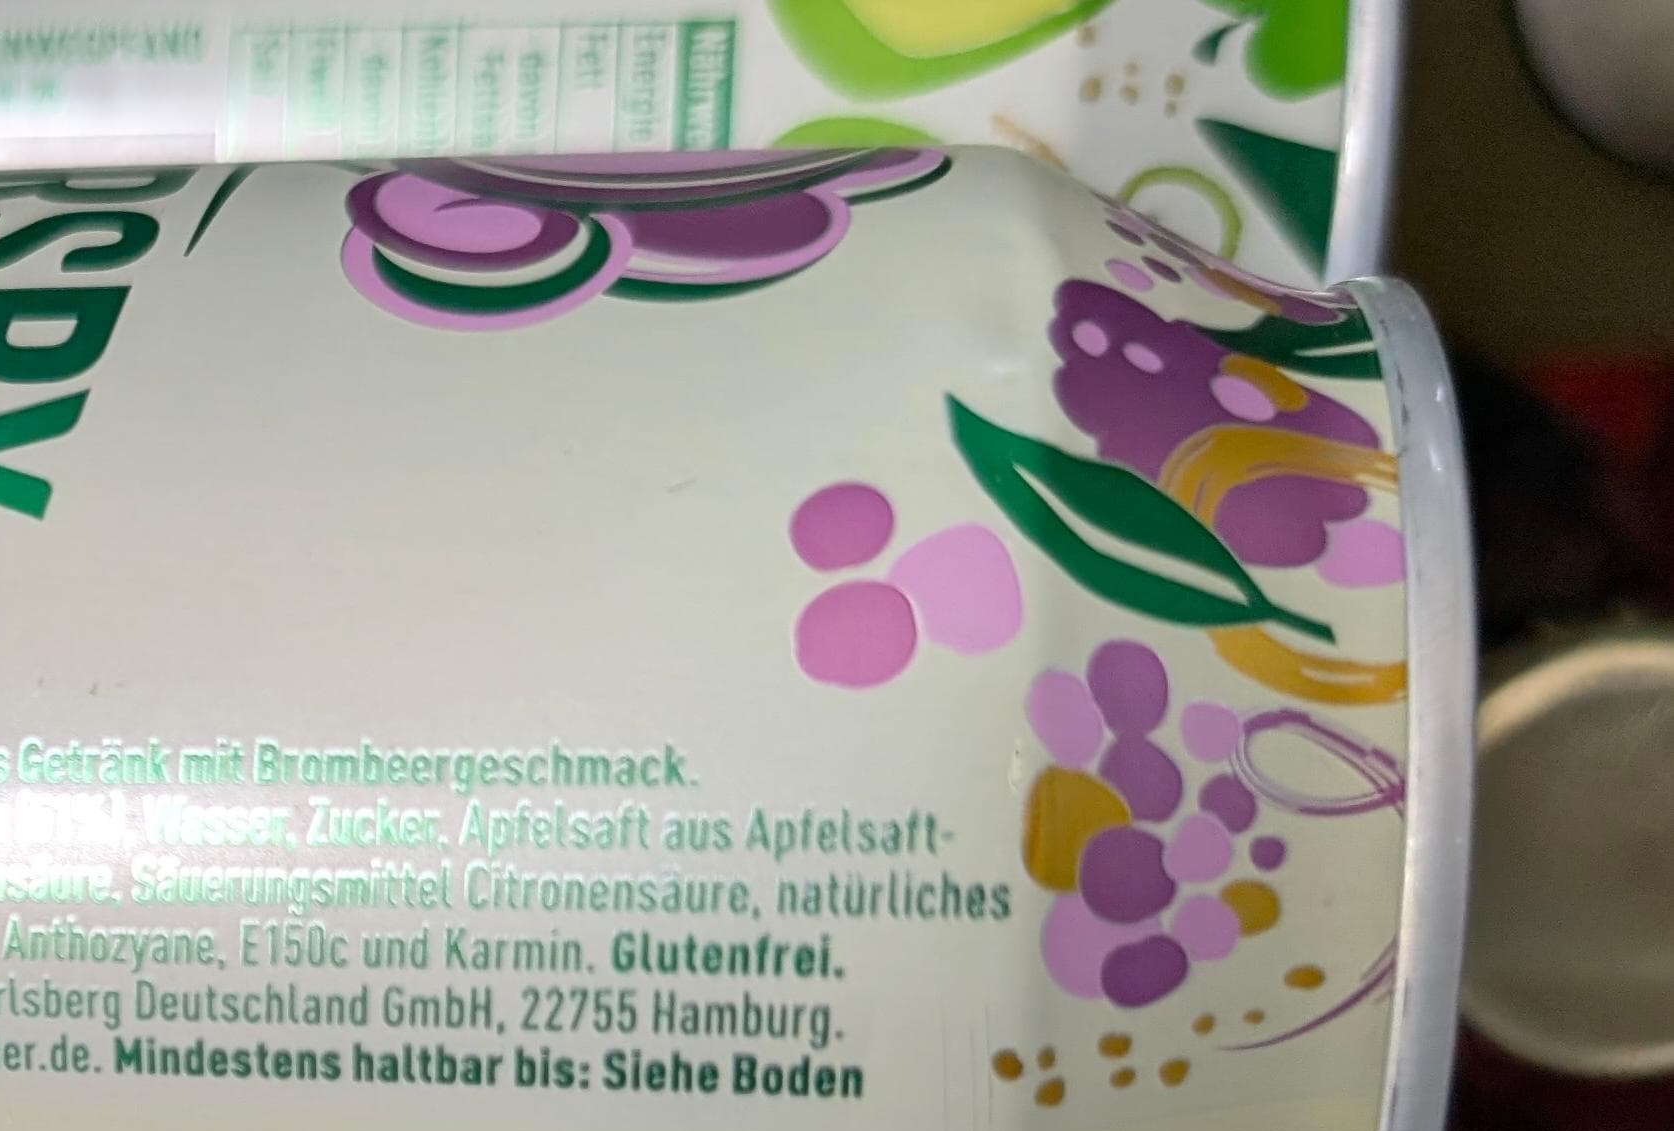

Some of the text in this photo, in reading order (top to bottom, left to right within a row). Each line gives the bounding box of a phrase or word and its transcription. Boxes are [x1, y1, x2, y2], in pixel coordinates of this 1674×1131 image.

[18, 735, 172, 784] Getränk
[179, 738, 245, 785] mit
[254, 738, 700, 795] Brombeergeschmack.
[142, 794, 298, 851] Wasser,
[460, 798, 652, 855] Apfelsaft
[662, 814, 733, 852] aus
[745, 807, 956, 860] Apfelsaft-
[131, 853, 453, 914] Säuerungsmittel
[464, 858, 763, 920] Citronensäure,
[776, 870, 1012, 922] natürliches
[2, 911, 226, 971] Anthozyane,
[239, 918, 348, 969] E150c
[362, 923, 431, 969] und
[444, 926, 596, 974] Karmin.
[612, 931, 845, 980] Glutenfrei.
[135, 978, 369, 1026] Deutschland
[382, 986, 506, 1036] GmbH,
[520, 988, 638, 1034] 22755
[652, 989, 844, 1049] Hamburg.
[113, 1035, 341, 1082] Mindestens
[353, 1044, 503, 1087] haltbar
[514, 1047, 591, 1090] bis:
[602, 1050, 719, 1094] Siehe
[732, 1054, 864, 1100] Boden
